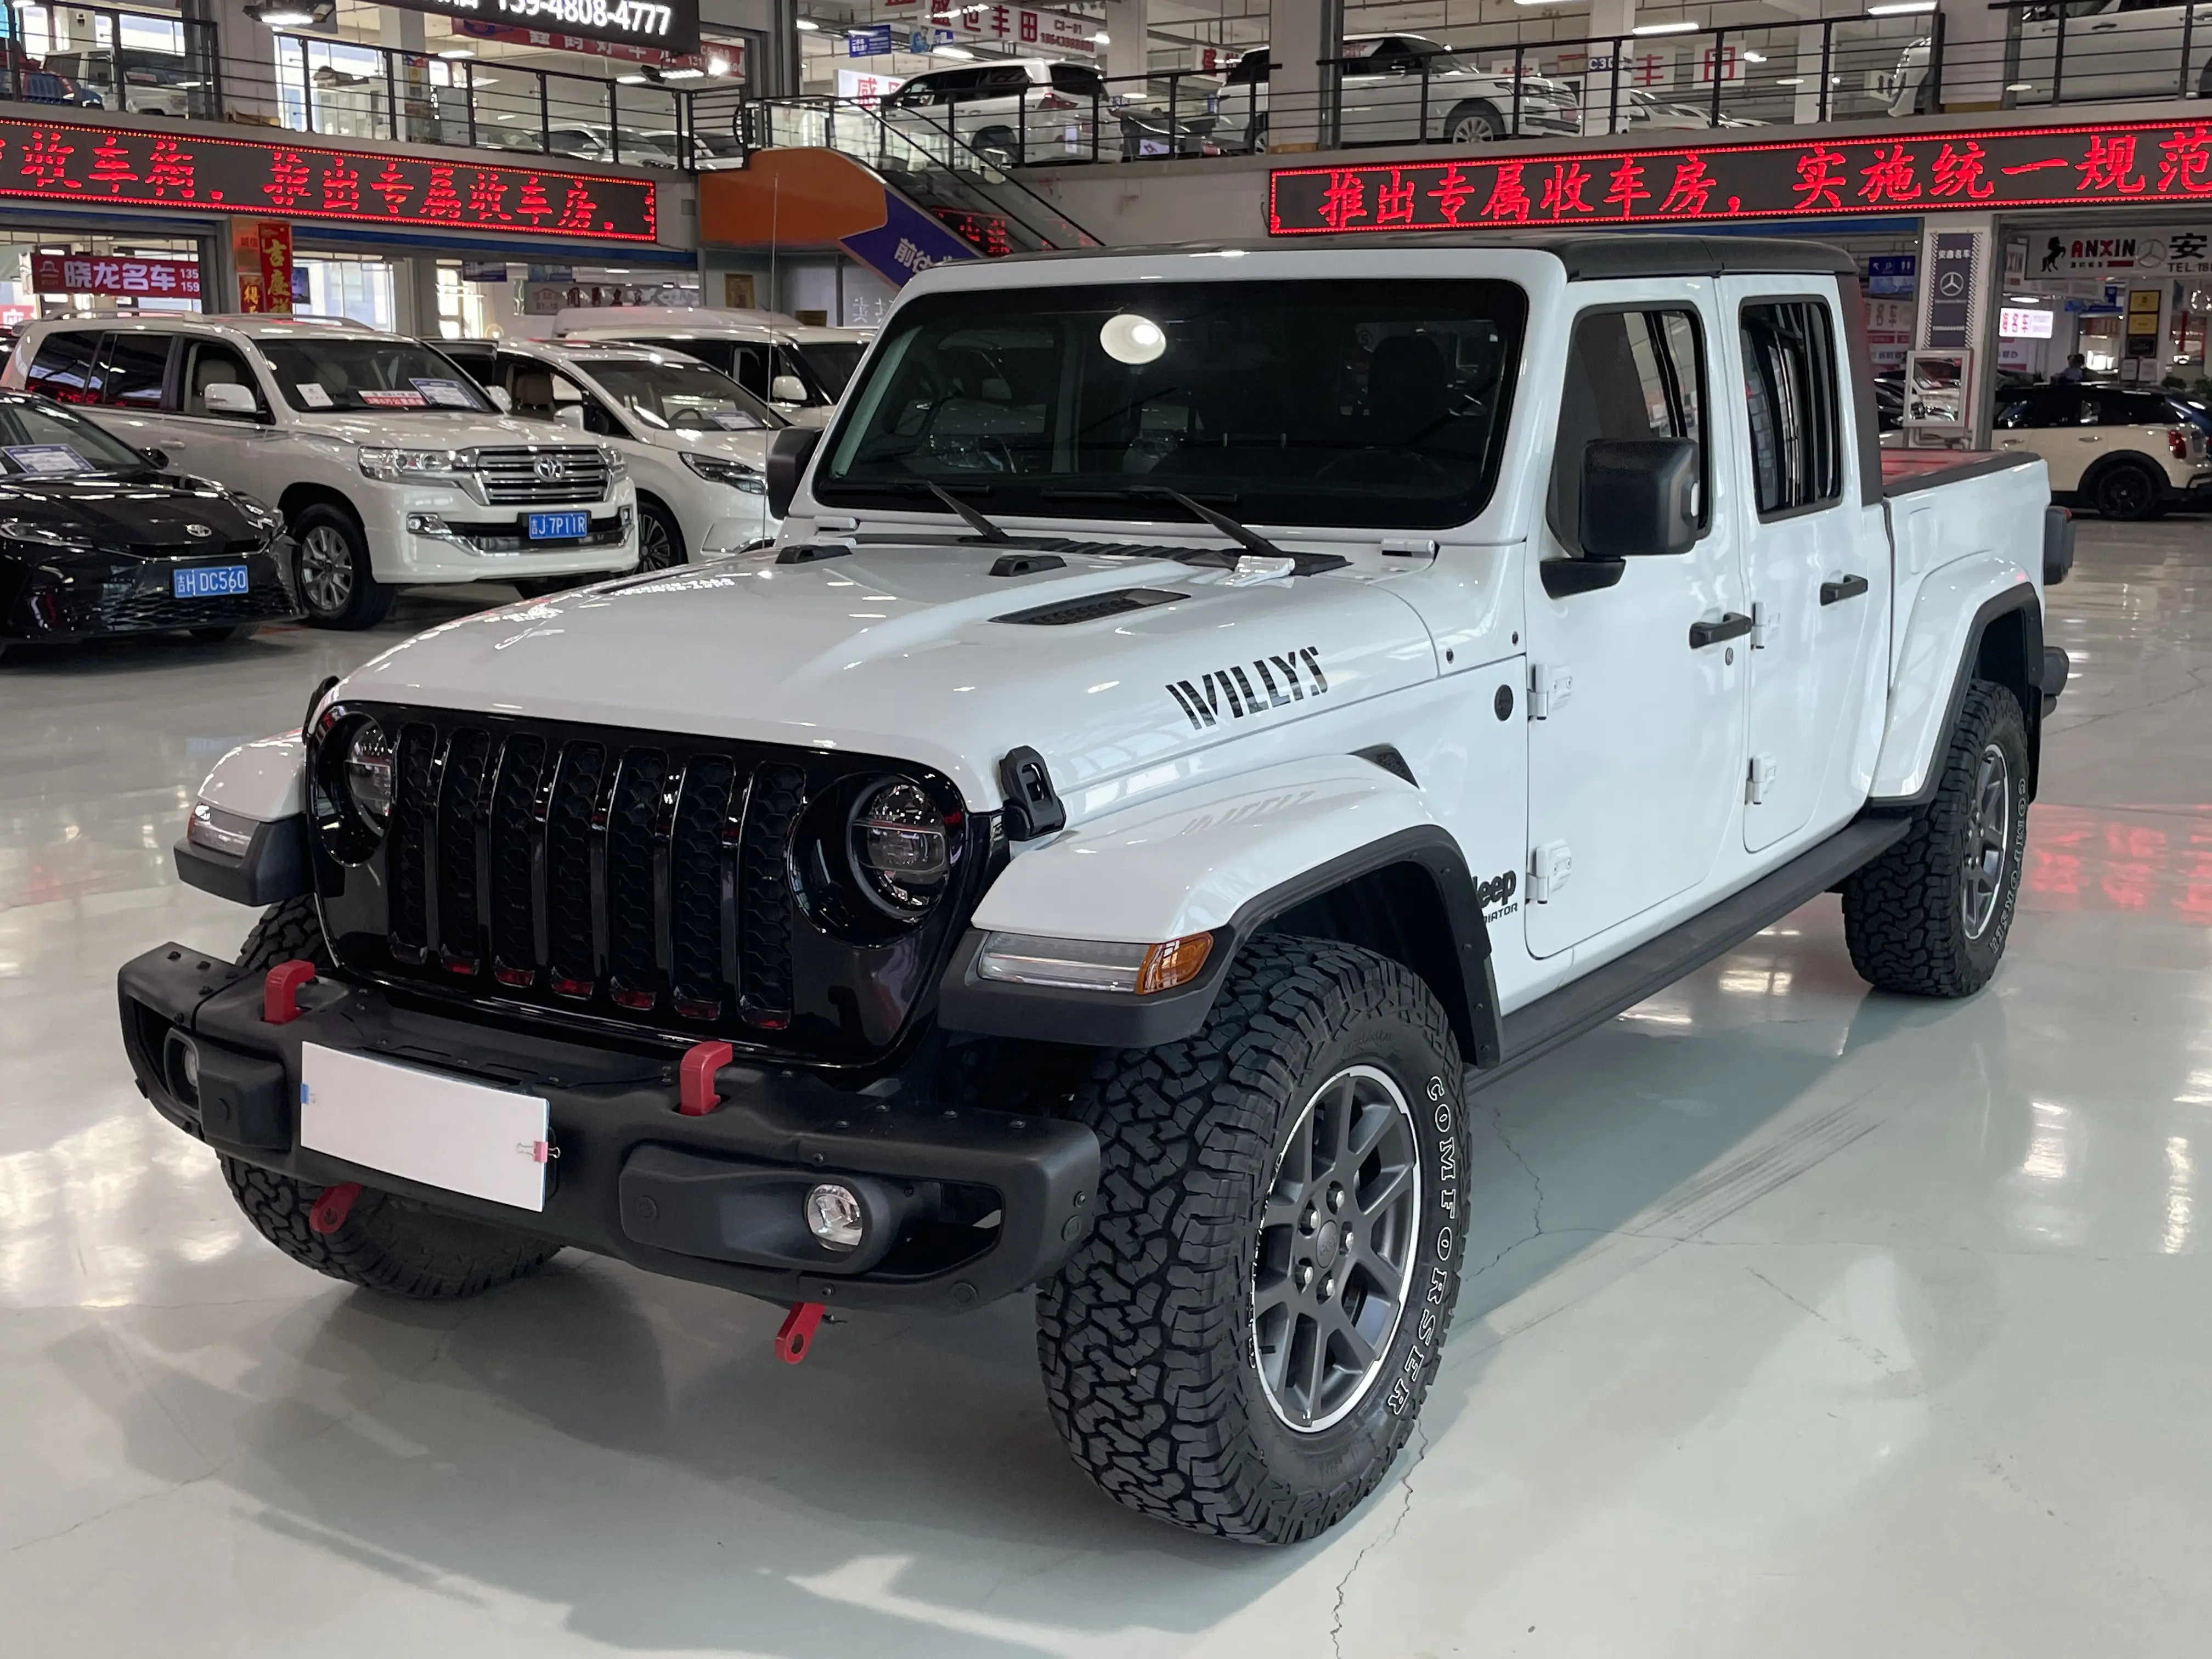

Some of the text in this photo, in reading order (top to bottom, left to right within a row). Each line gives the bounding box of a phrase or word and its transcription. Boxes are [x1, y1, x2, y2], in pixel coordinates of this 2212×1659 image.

[894, 238, 953, 275] 前往
[2071, 239, 2136, 257] ANXIN
[2169, 233, 2207, 259] 安
[64, 261, 176, 291] 晓龙名车
[180, 268, 199, 279] 135
[181, 281, 200, 292] 159
[1165, 646, 1328, 730] WILLYS
[1386, 1075, 1457, 1416] COMFORSER
